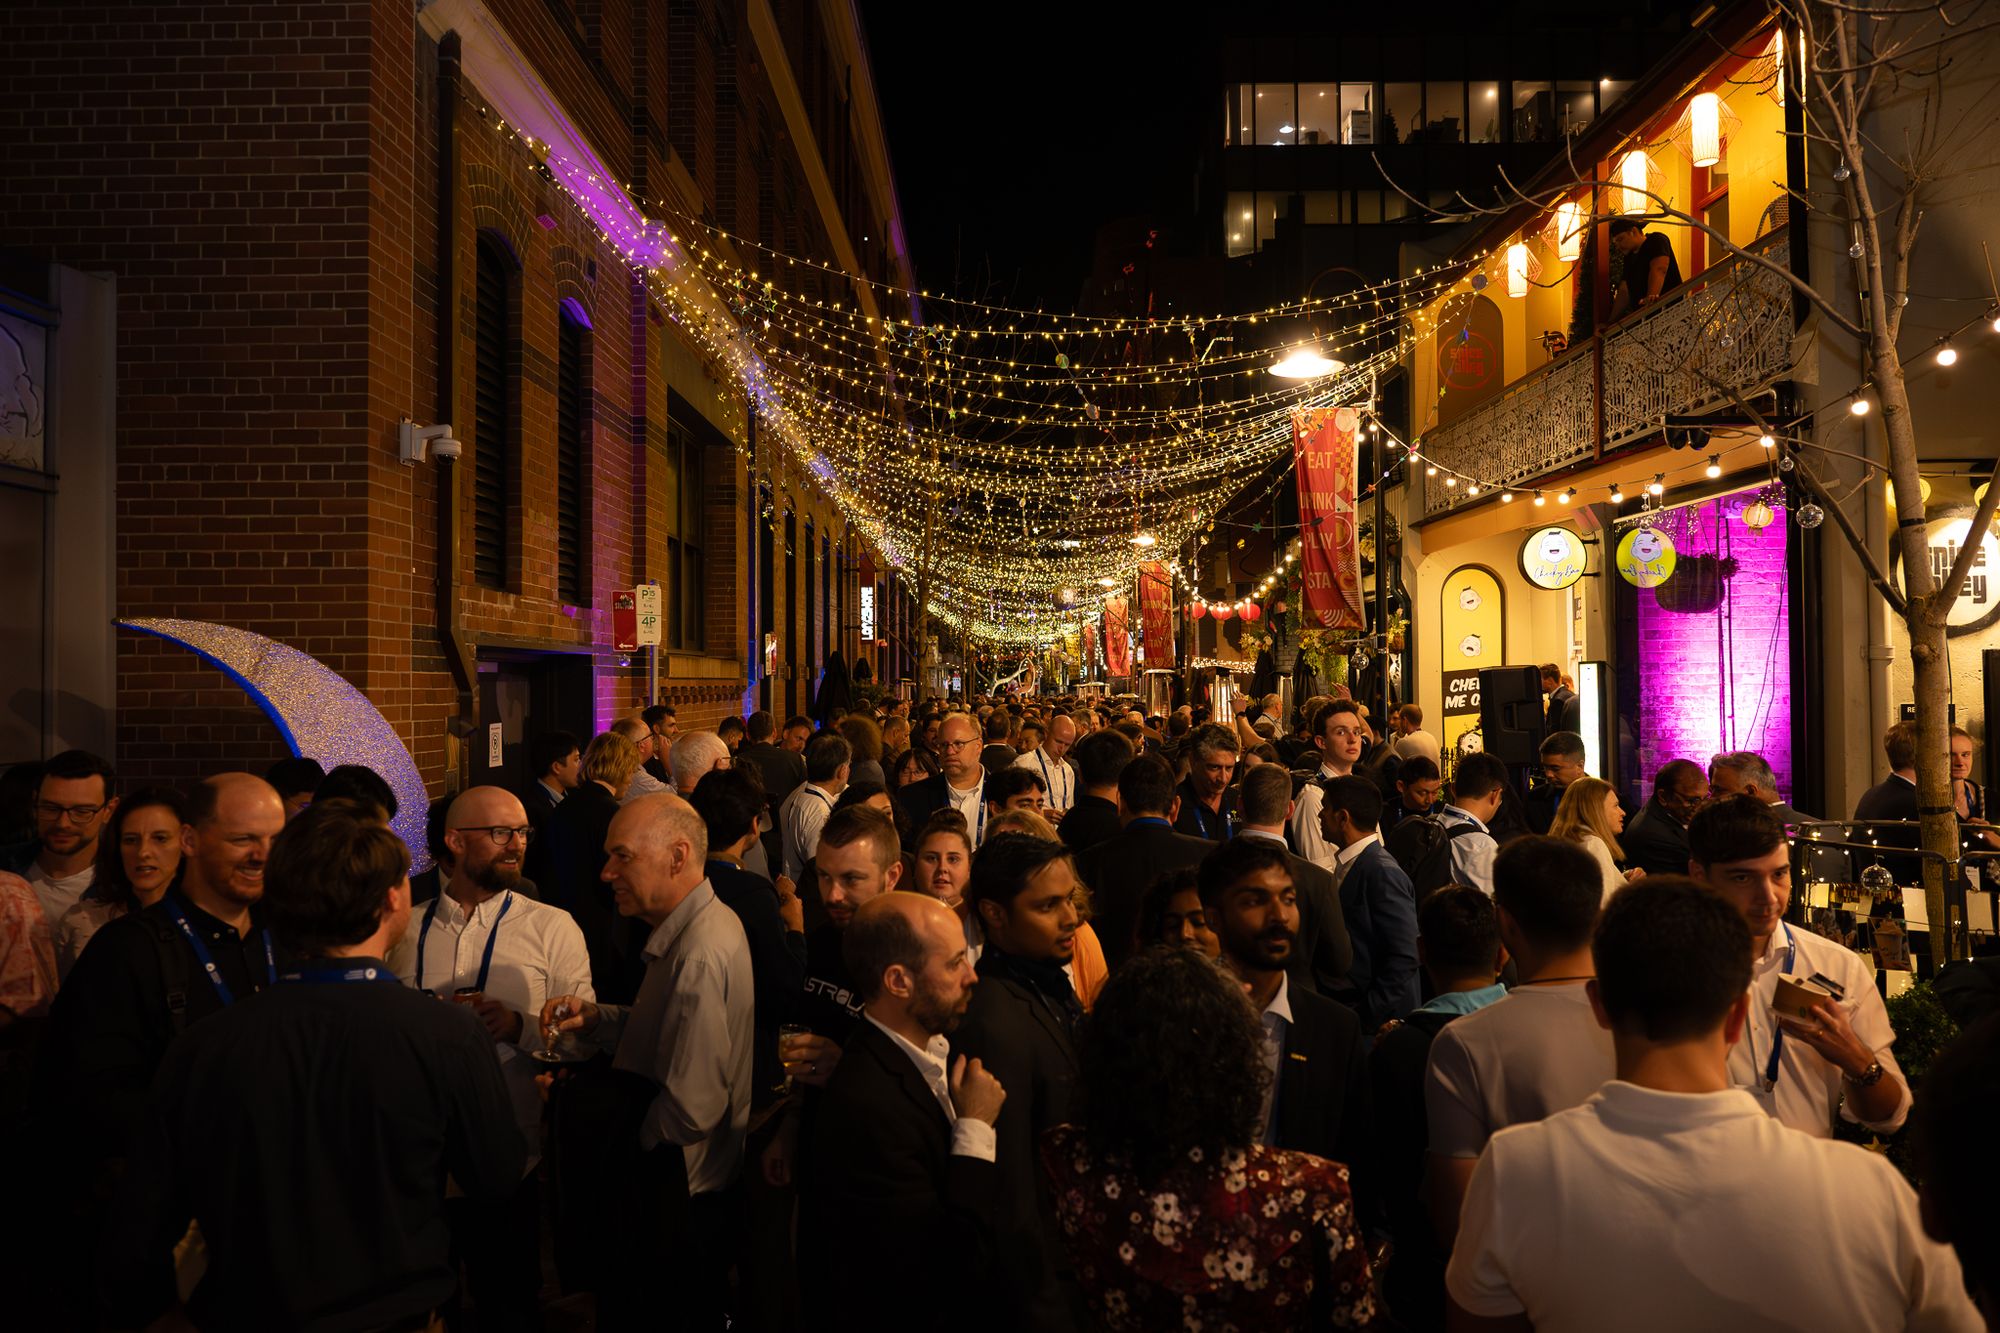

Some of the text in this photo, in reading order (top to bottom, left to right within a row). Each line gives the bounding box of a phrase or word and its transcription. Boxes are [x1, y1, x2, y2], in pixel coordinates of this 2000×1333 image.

[1308, 451, 1333, 469] EAT
[1533, 564, 1564, 586] Cheeky
[641, 616, 656, 625] 4P
[1445, 694, 1468, 709] ME
